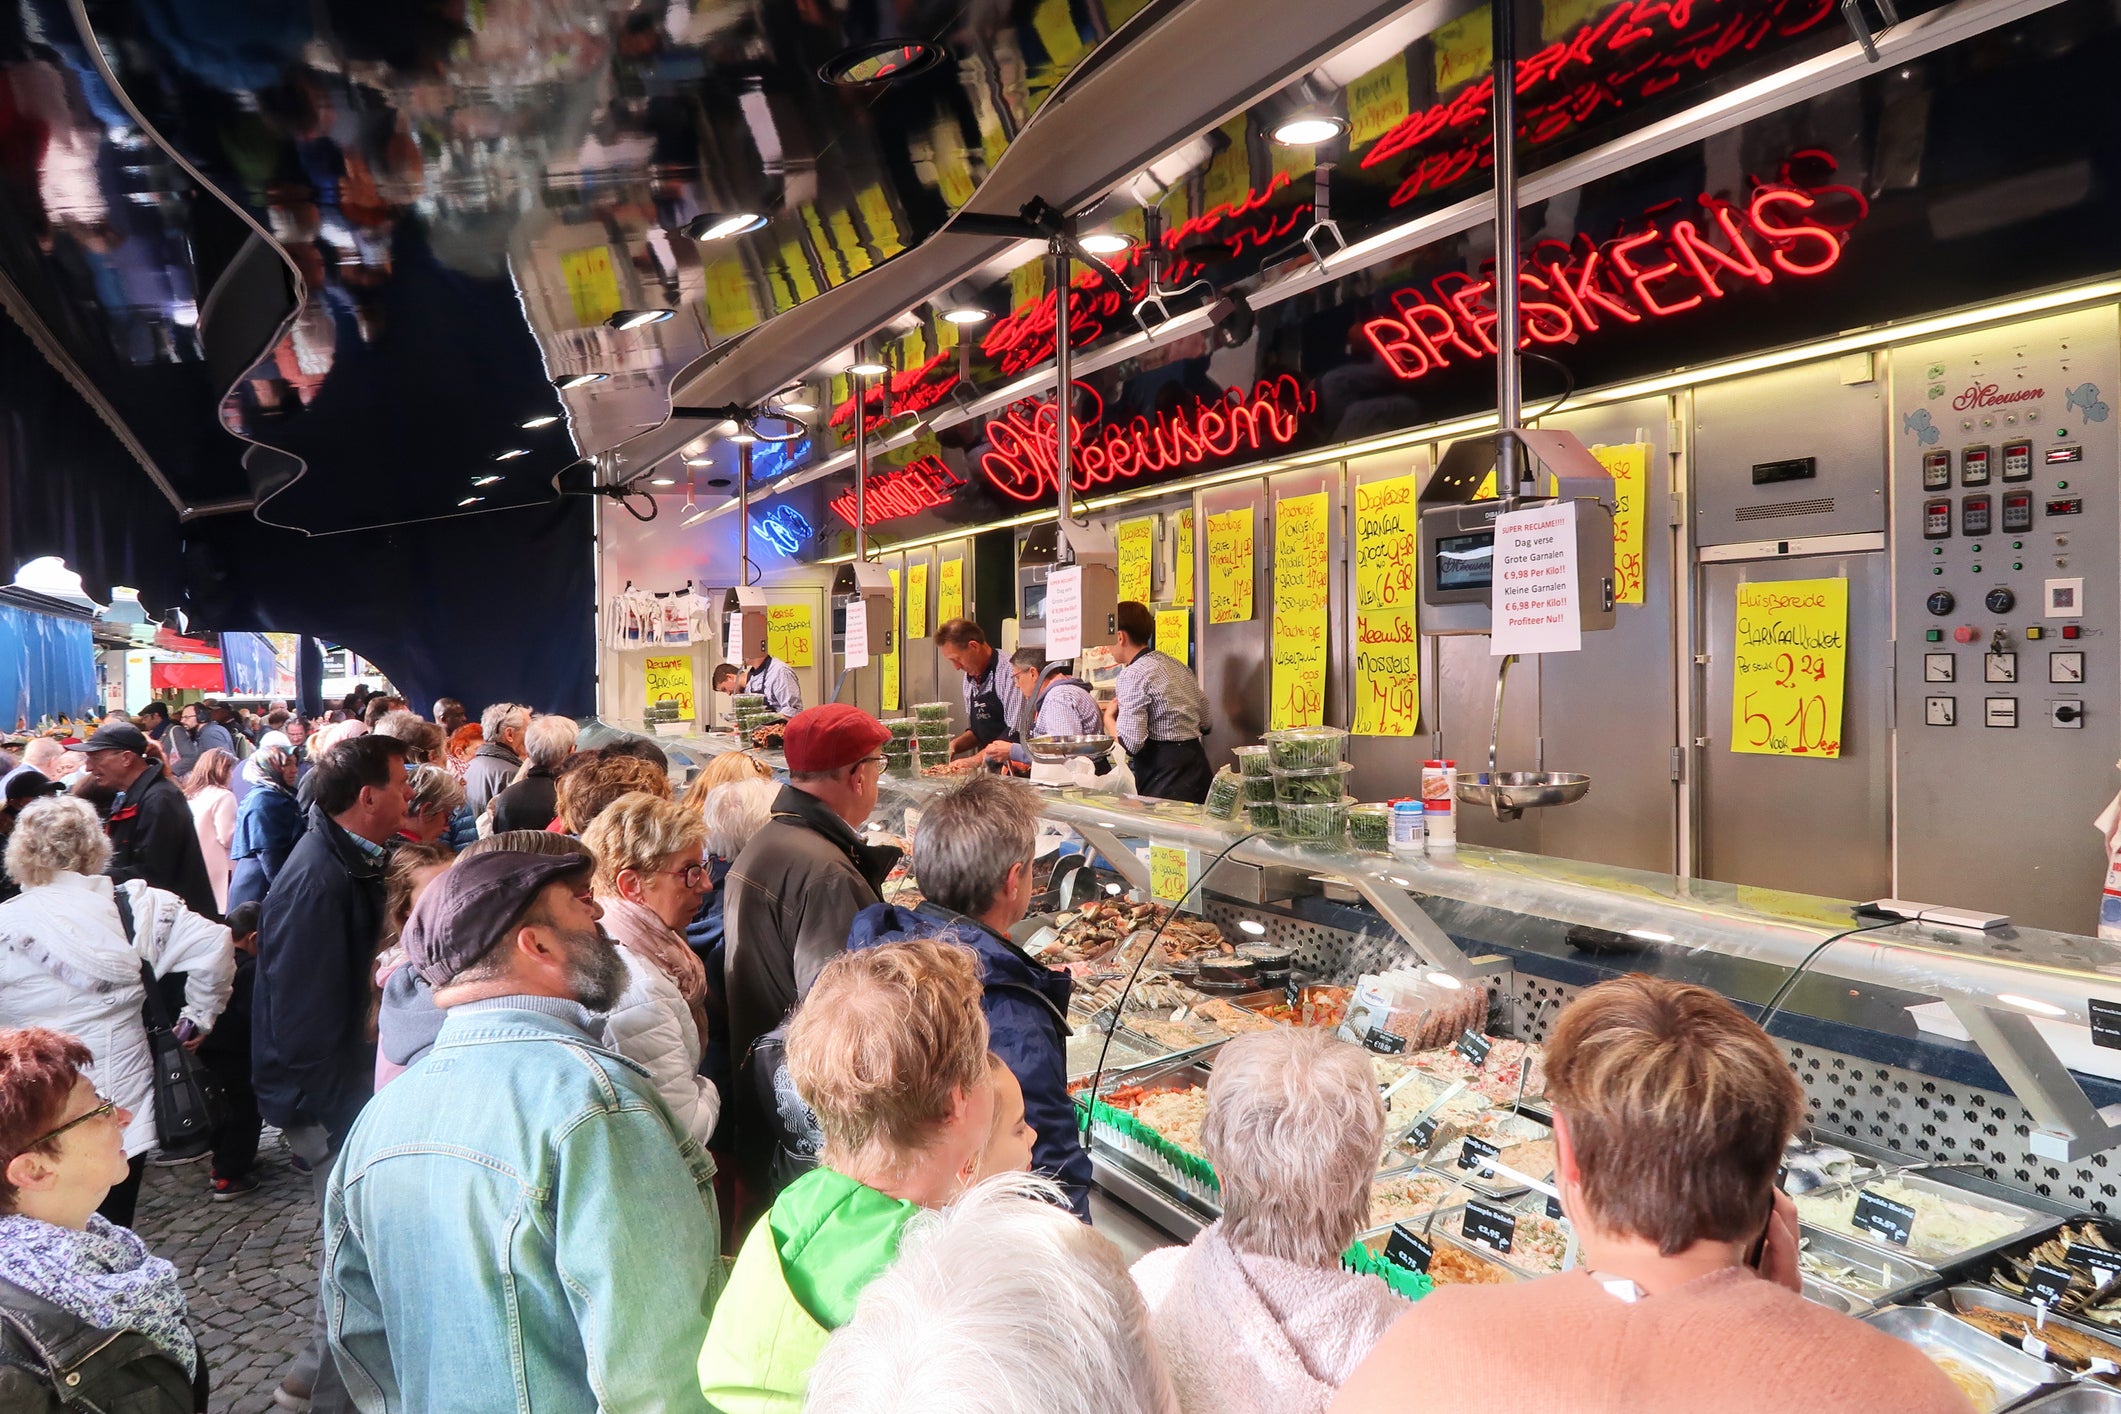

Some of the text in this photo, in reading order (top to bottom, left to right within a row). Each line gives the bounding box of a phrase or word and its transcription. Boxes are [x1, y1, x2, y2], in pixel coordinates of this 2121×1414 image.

[1362, 189, 1842, 380] BRESKENS
[1952, 383, 2046, 412] Meeusen
[980, 398, 1297, 501] Meeusen
[1502, 518, 1565, 534] SUPER RECLAME!!!!
[1515, 536, 1554, 548] Dag verse
[1504, 550, 1564, 564] Grote Garnalen
[1503, 565, 1566, 580] € 9,98 Per Kilo!!
[1504, 582, 1566, 595] Kleine Garnalen
[1504, 597, 1567, 611] € 6,98 Per Kilo!!
[1508, 614, 1564, 626] Profiteer Nu!!
[1775, 652, 1826, 688] 2,29
[1744, 691, 1772, 746] 5
[1785, 695, 1826, 752] 10
